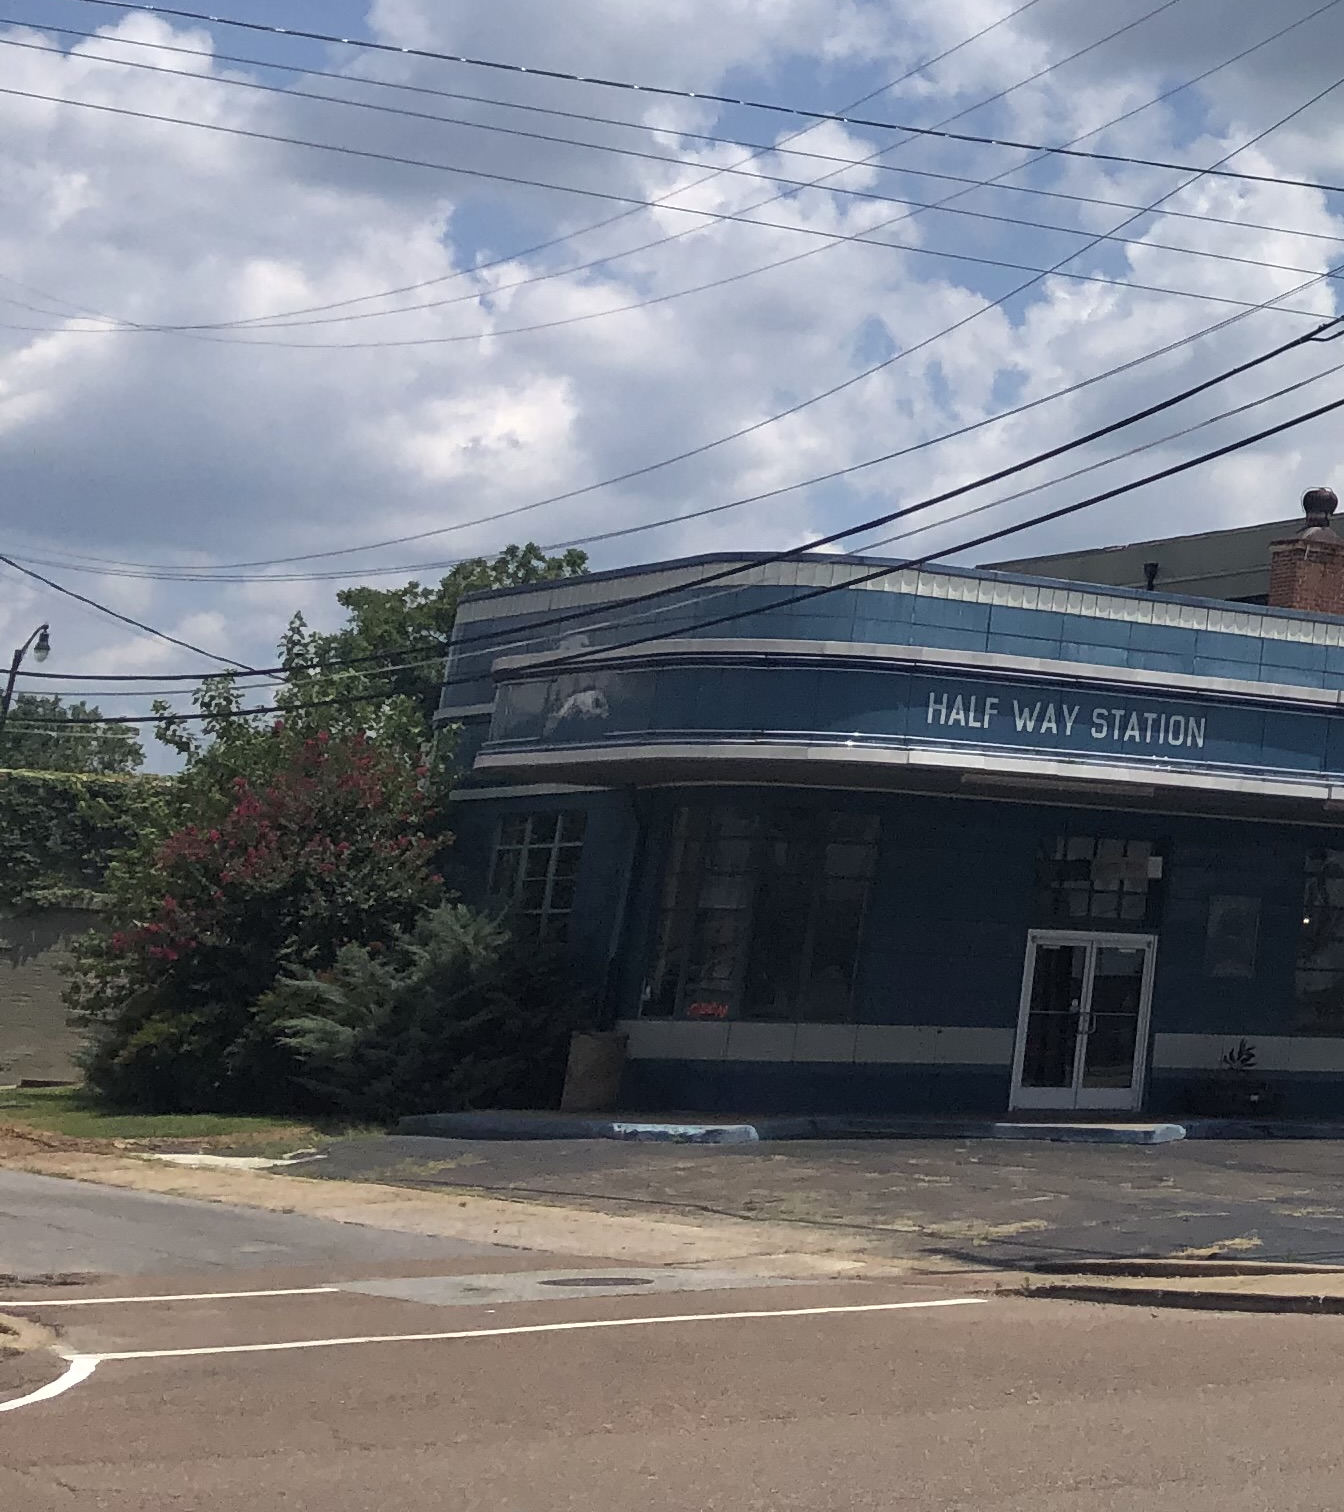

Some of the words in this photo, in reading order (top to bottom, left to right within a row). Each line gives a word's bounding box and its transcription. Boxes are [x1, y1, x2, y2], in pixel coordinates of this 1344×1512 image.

[927, 691, 999, 729] HALF
[1012, 699, 1080, 736] WAY
[1090, 707, 1207, 748] STATION
